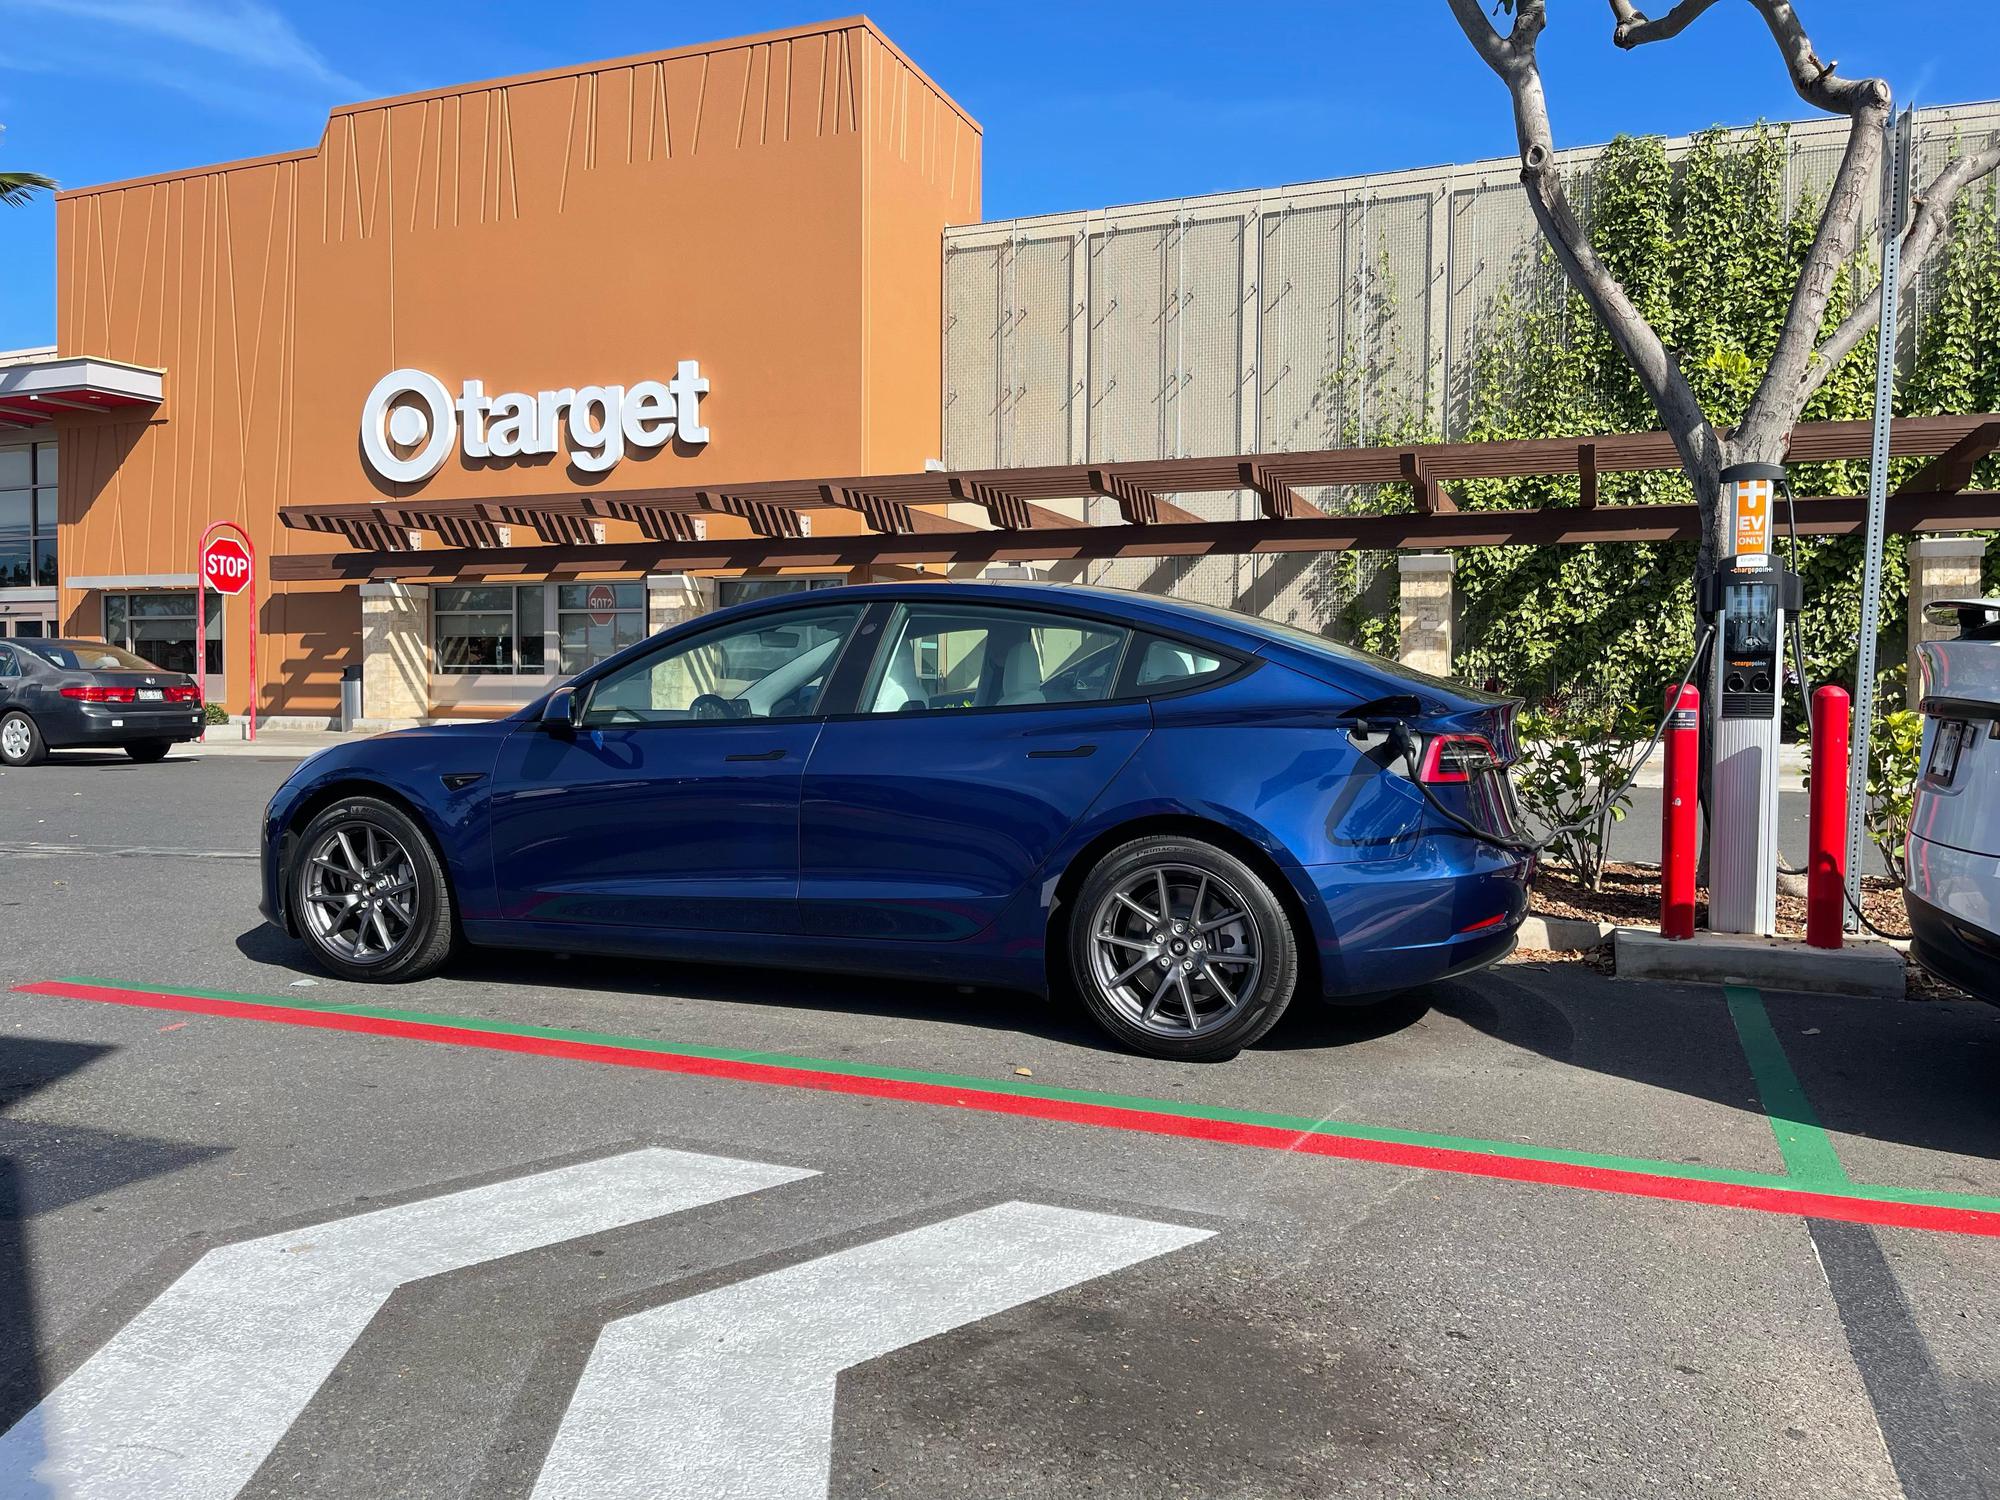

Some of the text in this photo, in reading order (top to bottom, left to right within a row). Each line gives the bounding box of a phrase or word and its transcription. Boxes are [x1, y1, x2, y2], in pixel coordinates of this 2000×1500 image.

[456, 360, 710, 472] target
[1739, 515, 1764, 531] EV
[1738, 536, 1764, 545] ONLY
[207, 553, 248, 578] STOP
